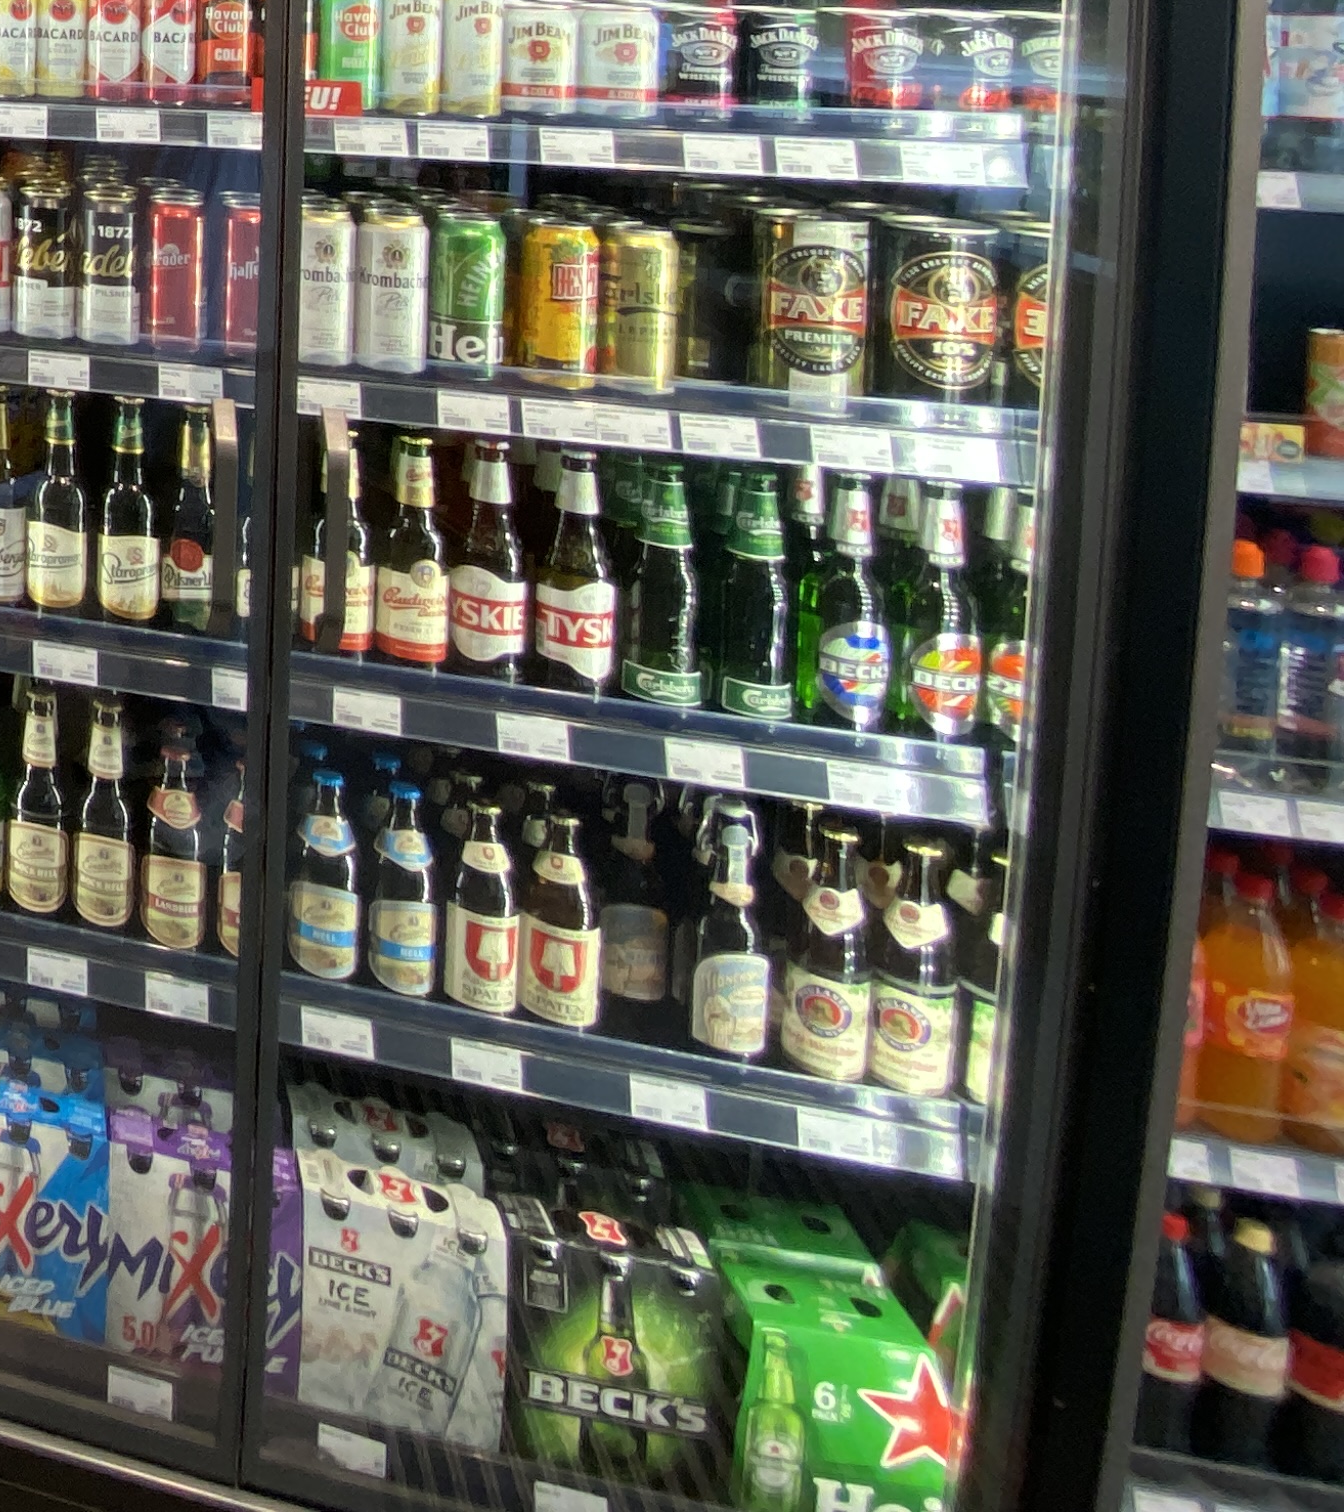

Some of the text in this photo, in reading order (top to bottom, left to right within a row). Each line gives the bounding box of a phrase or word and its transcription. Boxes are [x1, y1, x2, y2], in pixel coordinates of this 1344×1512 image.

[214, 20, 244, 33] Club
[773, 294, 864, 323] FAXE
[900, 301, 995, 334] FAXE
[784, 329, 853, 345] PREMIUM
[931, 341, 976, 356] 10%
[107, 1225, 221, 1322] MiX
[328, 1278, 370, 1308] ICE
[180, 1324, 225, 1346] ICE
[528, 1373, 709, 1434] BECK'S
[813, 1380, 837, 1411] 6
